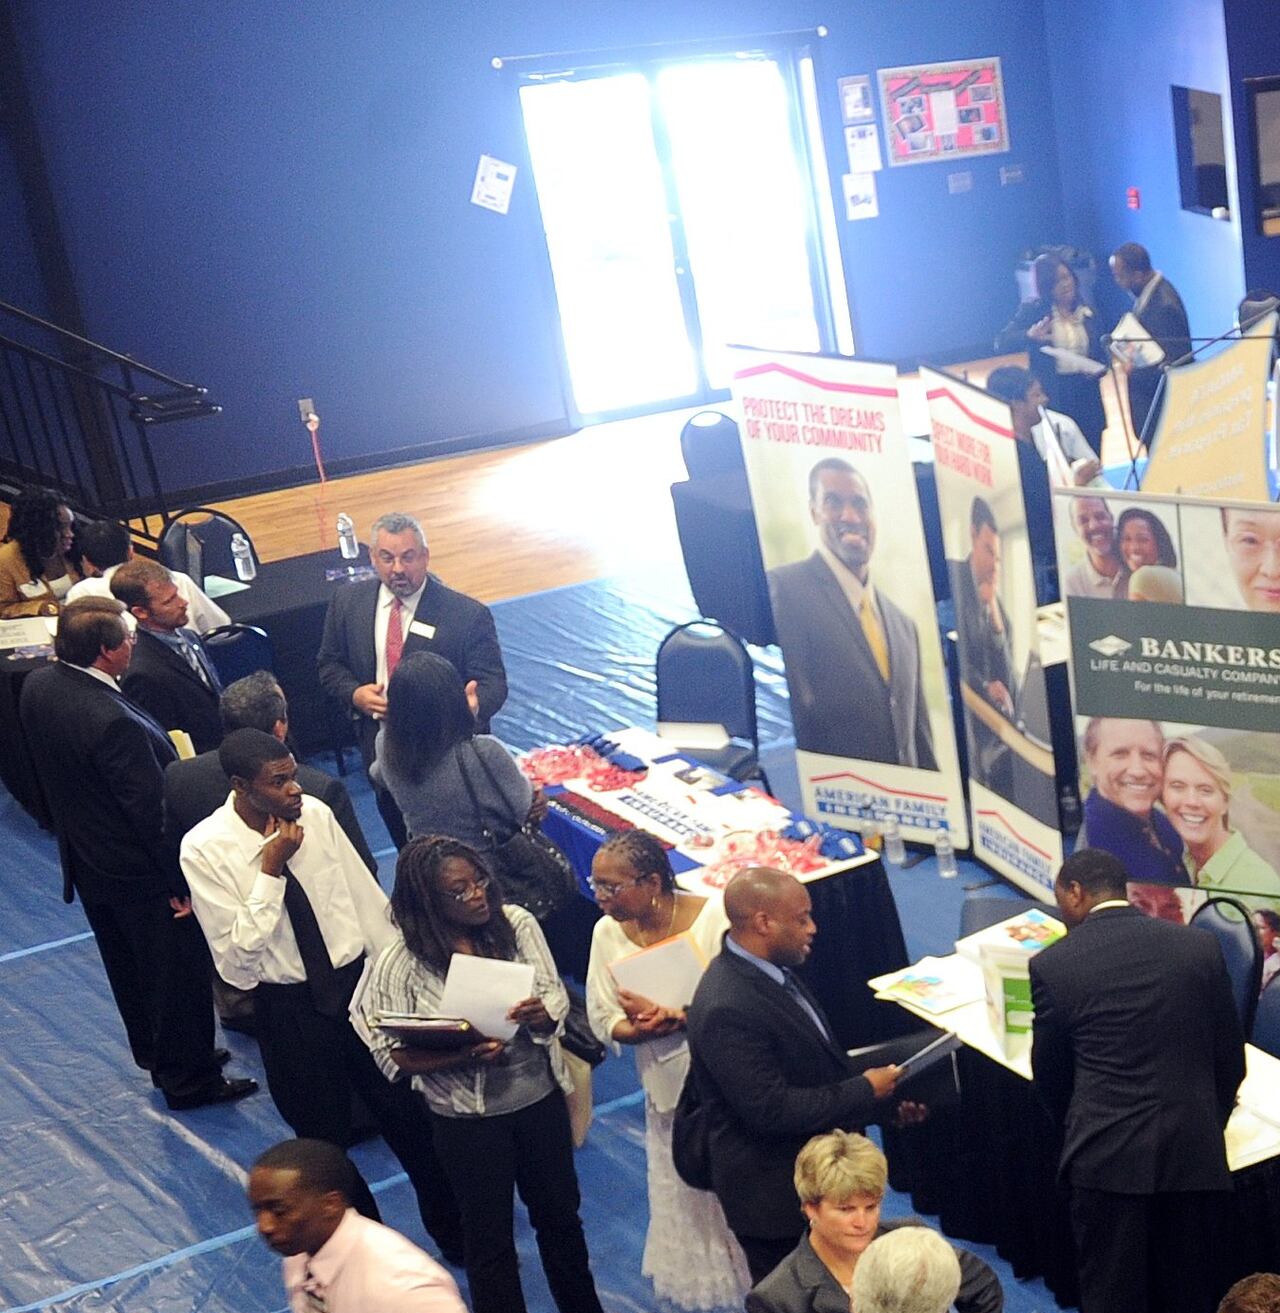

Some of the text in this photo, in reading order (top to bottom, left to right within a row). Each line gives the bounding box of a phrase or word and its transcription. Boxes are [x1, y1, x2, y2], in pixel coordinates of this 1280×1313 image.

[742, 397, 886, 432] PROTECT THE DREAMS
[745, 420, 883, 453] OF YOUR COMMUNITY
[1090, 659, 1120, 672] LIFE
[1122, 660, 1152, 674] AND
[1154, 663, 1219, 680] CASUALTY
[1134, 680, 1151, 692] For
[1153, 682, 1171, 695] the
[1173, 683, 1190, 696] life
[1191, 686, 1204, 698] of
[1206, 689, 1230, 701] your
[815, 786, 947, 816] AMERICAN FAMILY
